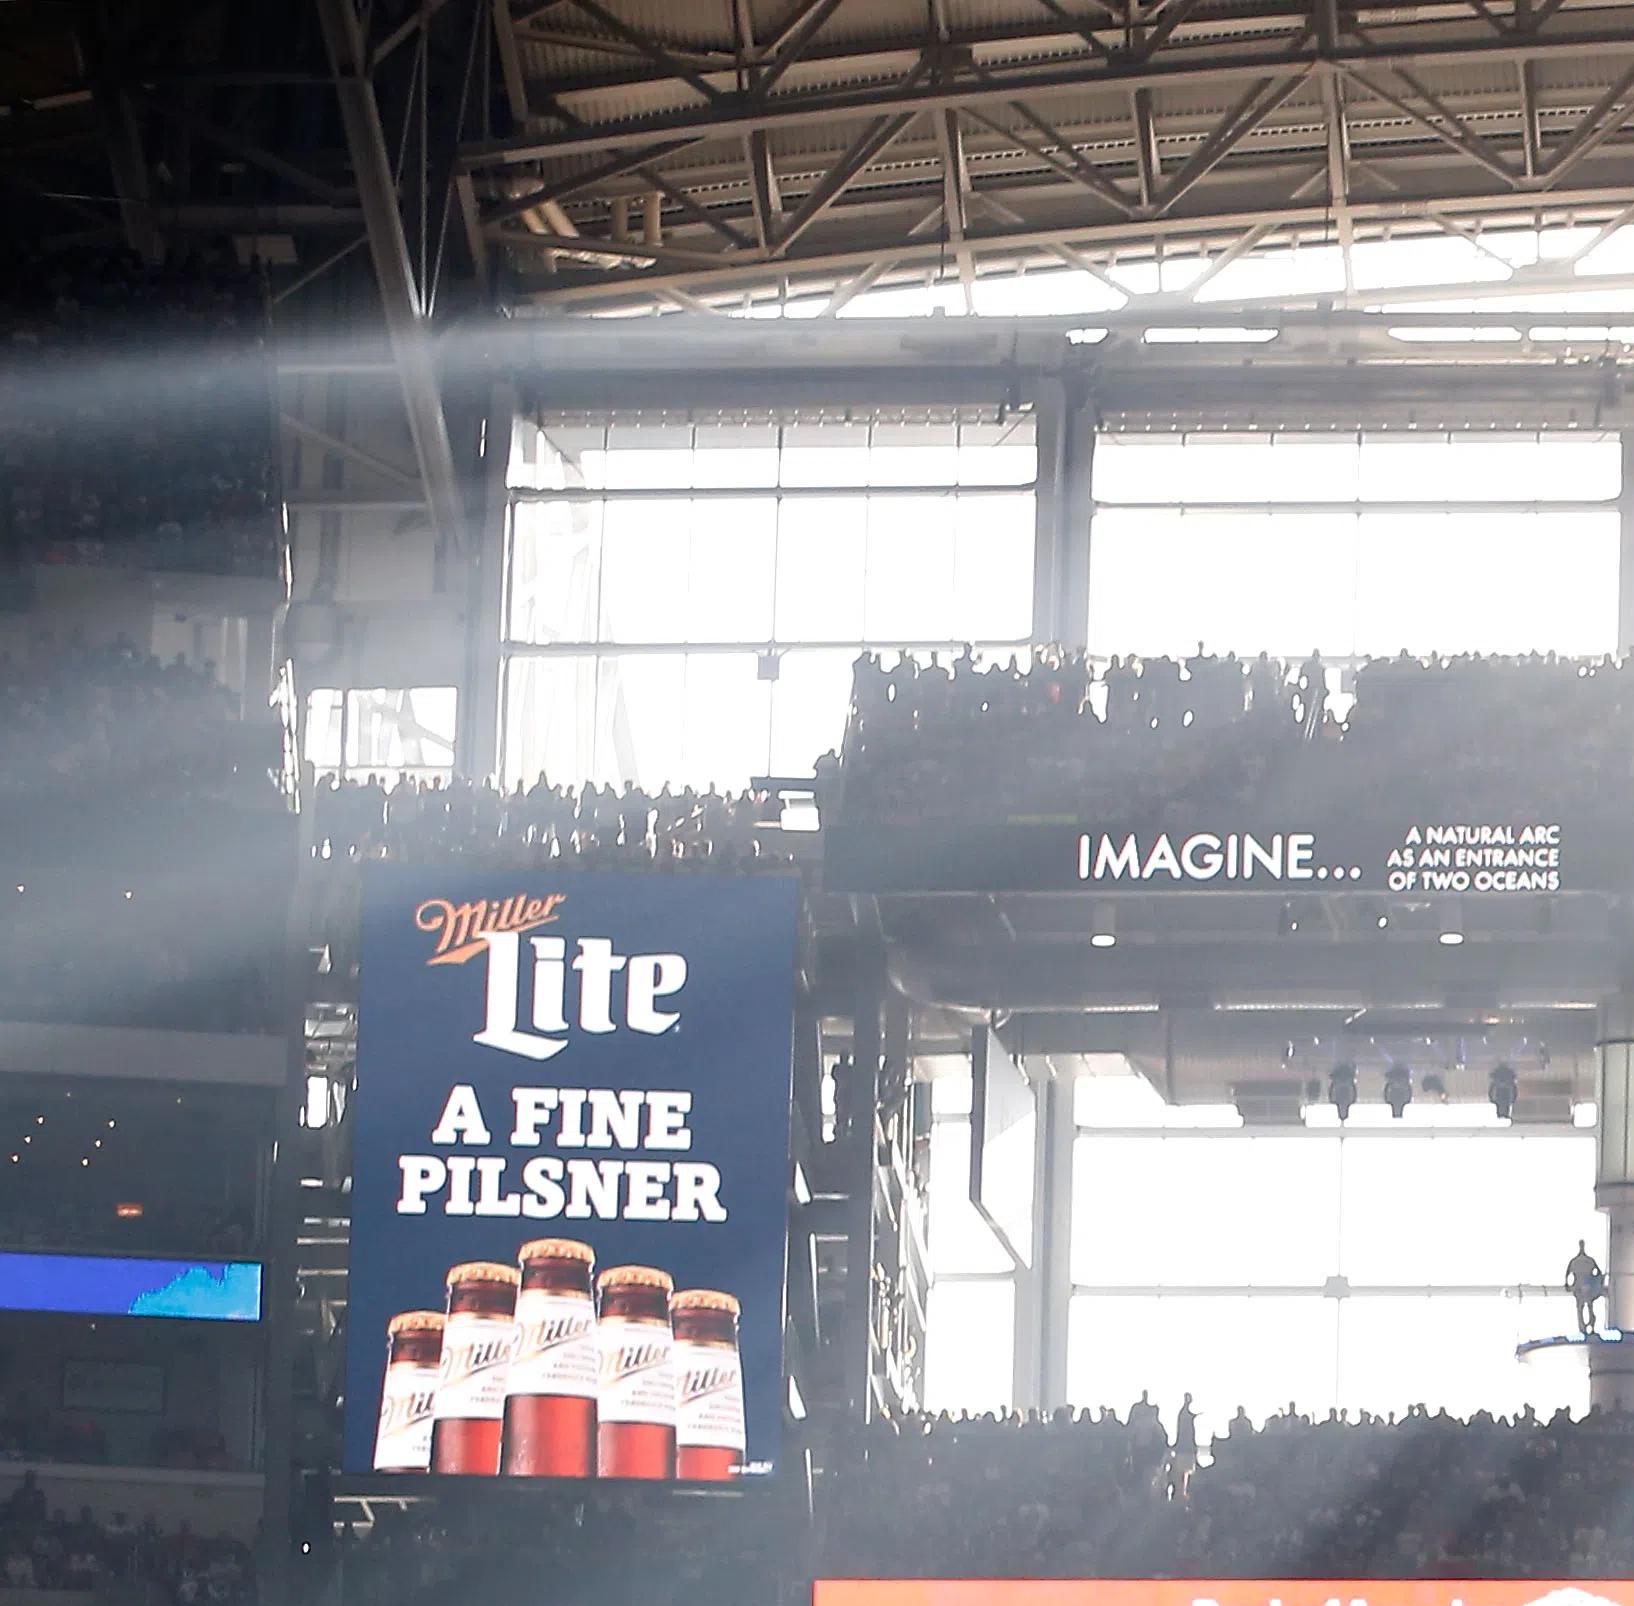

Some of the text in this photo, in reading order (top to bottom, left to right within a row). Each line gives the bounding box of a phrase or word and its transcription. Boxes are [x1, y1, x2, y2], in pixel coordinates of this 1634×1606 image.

[1078, 833, 1361, 881] IMAGINE...
[1387, 848, 1560, 869] AS AN ENTRANCE
[1405, 825, 1560, 846] A NATURAL ARC
[1388, 870, 1560, 892] OF TWO OCEANS
[415, 893, 567, 962] Miller
[472, 930, 688, 1061] Lite
[431, 1083, 692, 1151] A FINE
[396, 1154, 728, 1223] PILSNER
